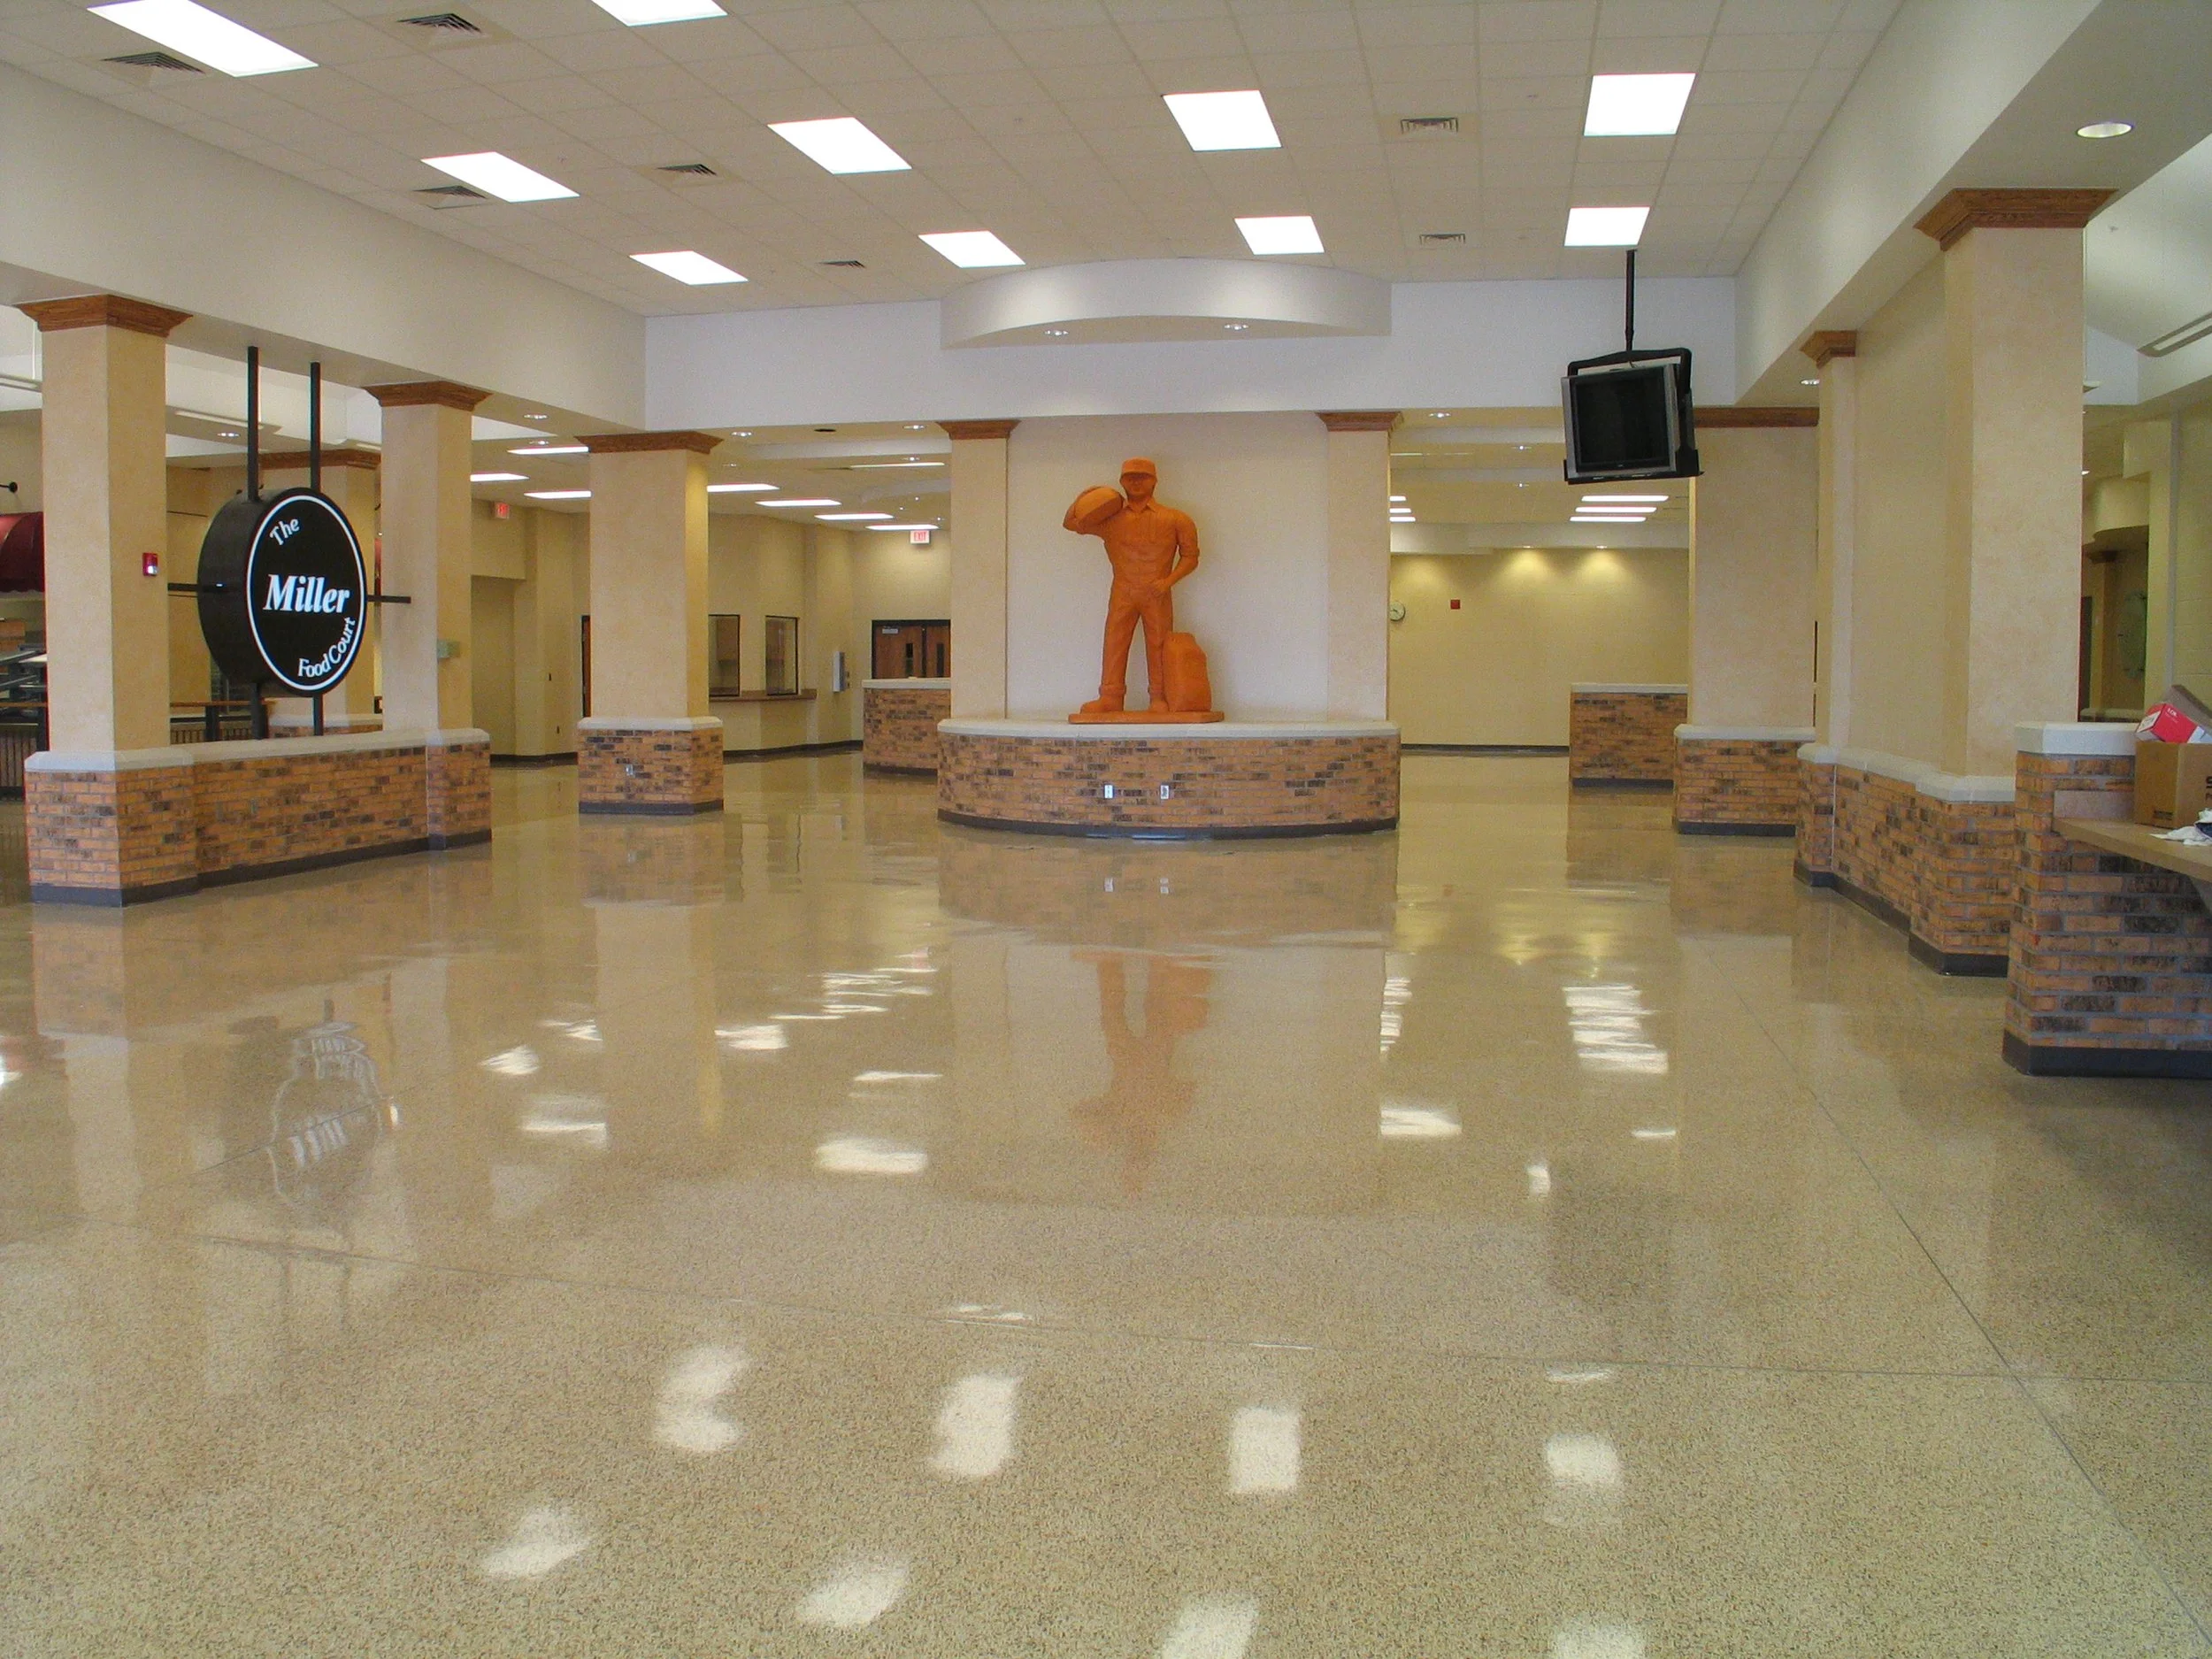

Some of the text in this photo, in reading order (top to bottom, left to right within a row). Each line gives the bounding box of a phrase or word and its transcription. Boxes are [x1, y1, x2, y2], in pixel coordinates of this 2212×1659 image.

[269, 518, 300, 545] The
[913, 531, 926, 542] EXIT
[262, 573, 349, 614] Miller
[297, 617, 355, 678] Food Court
